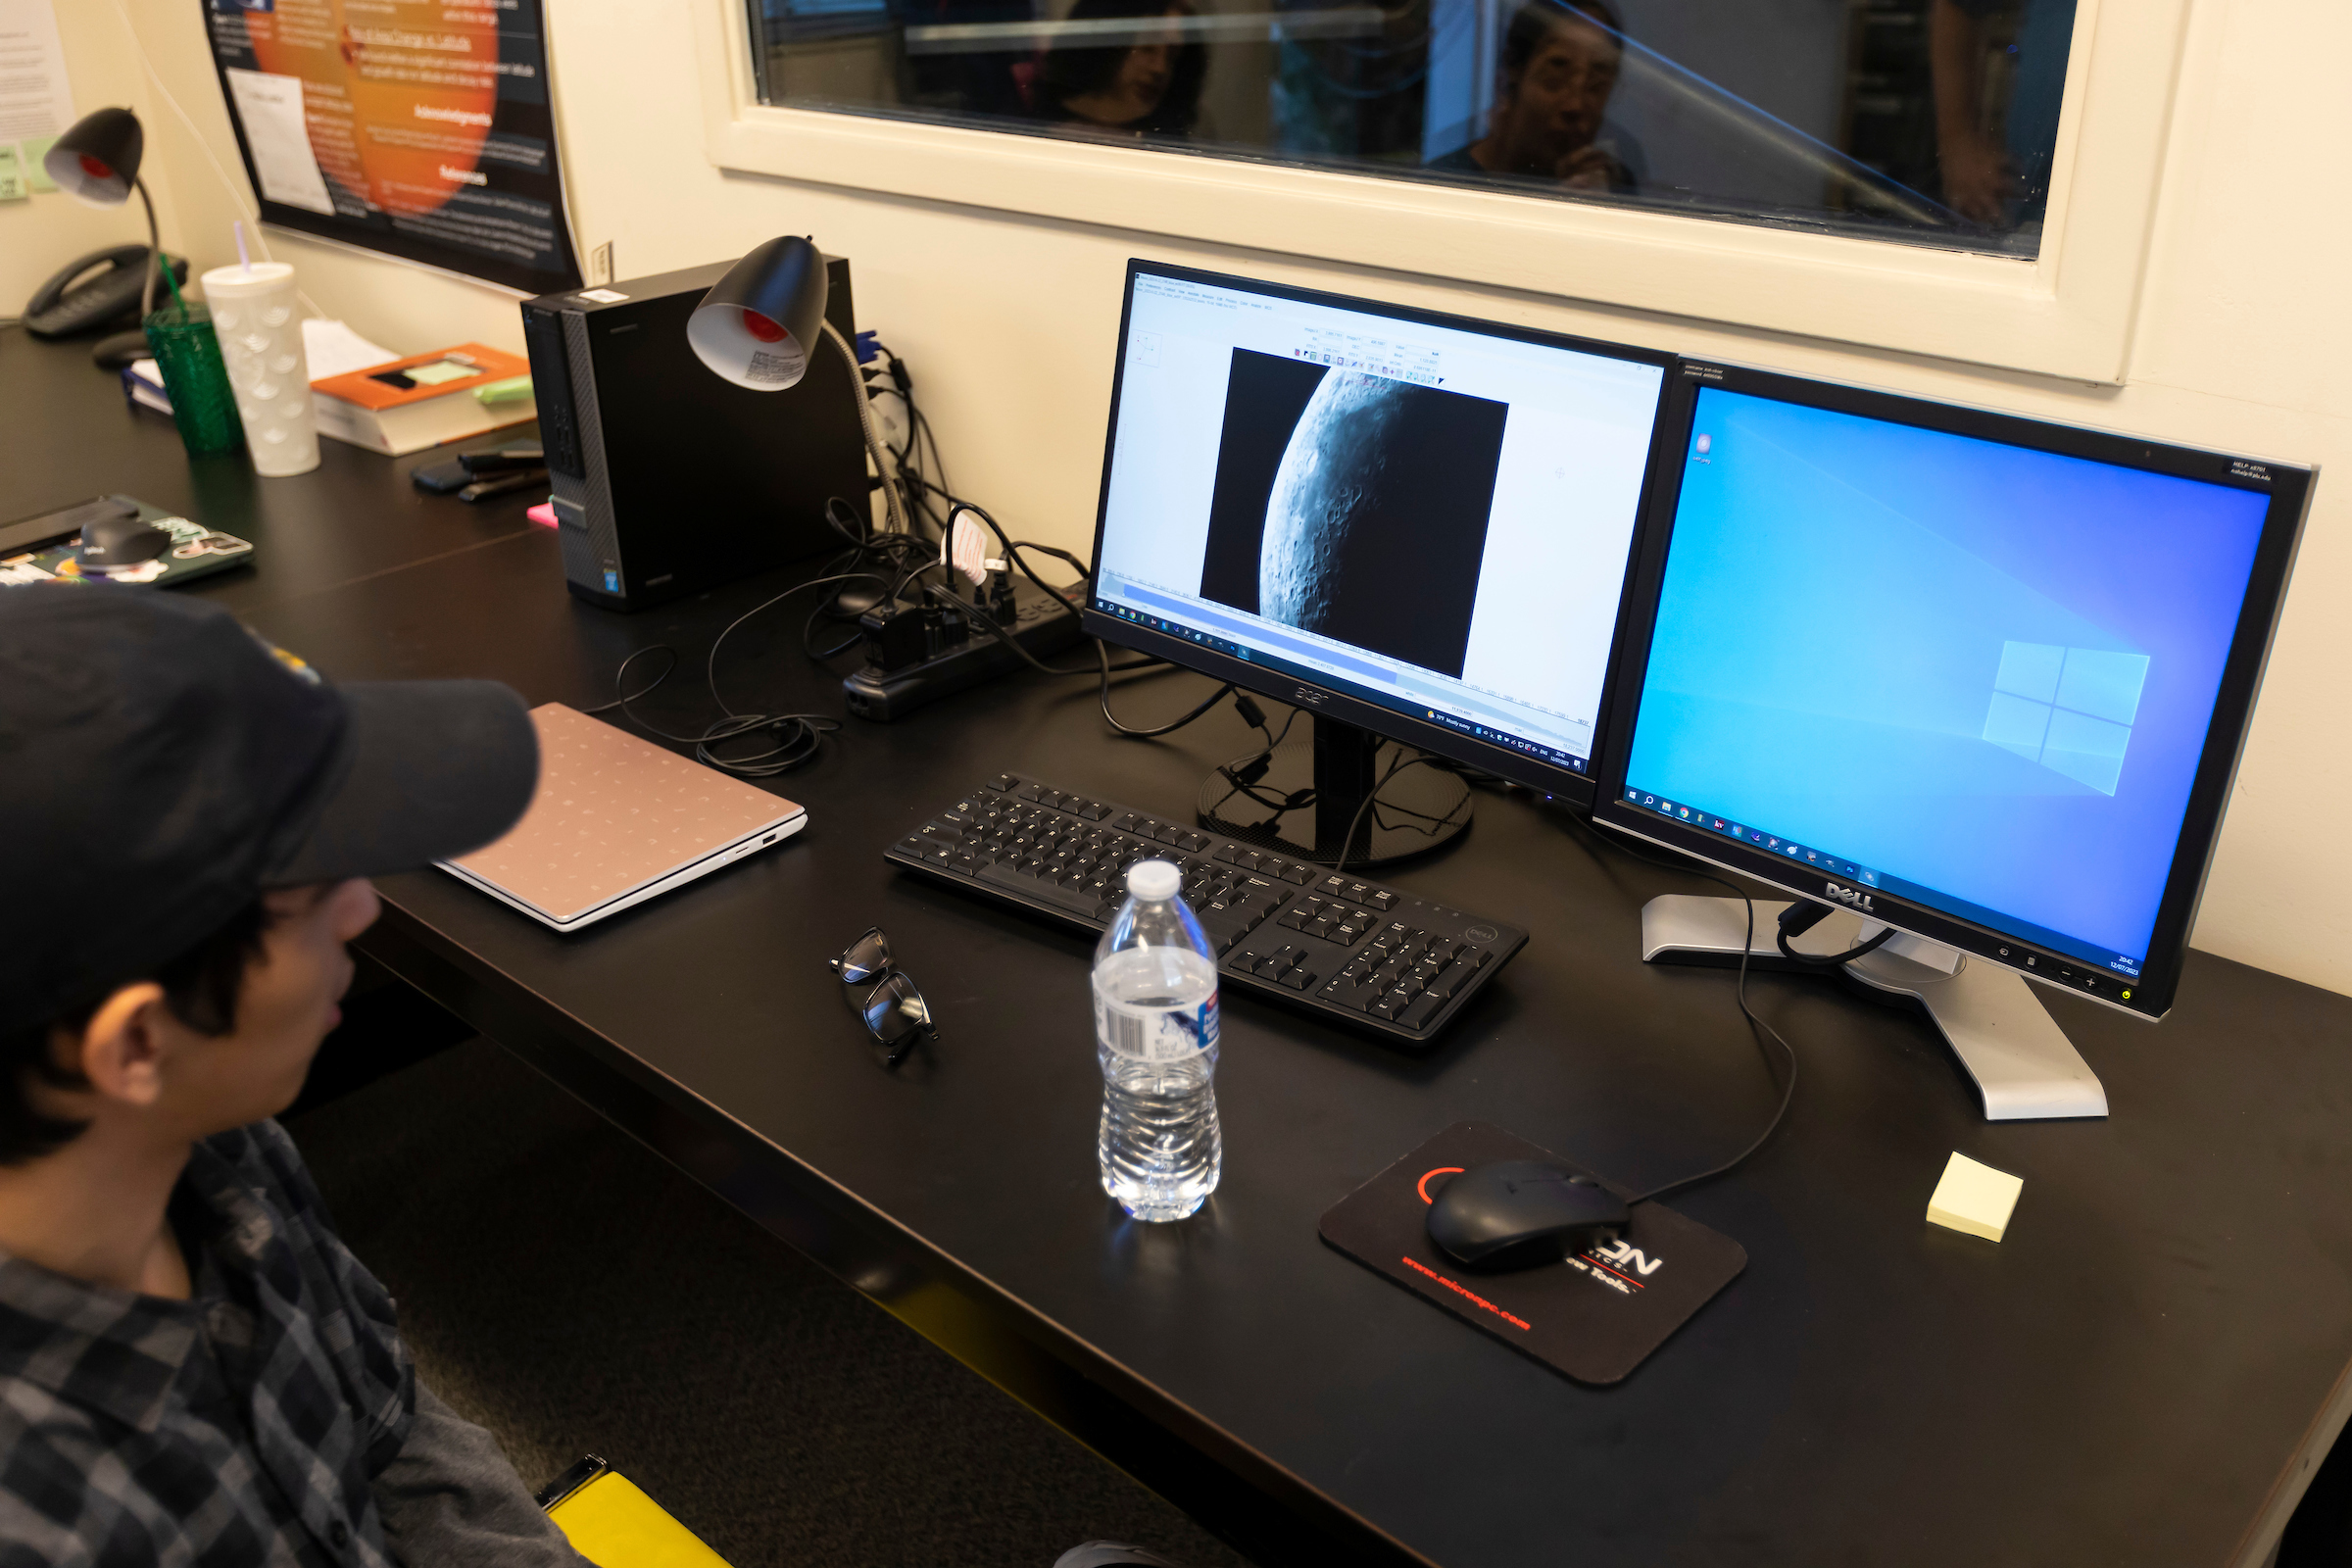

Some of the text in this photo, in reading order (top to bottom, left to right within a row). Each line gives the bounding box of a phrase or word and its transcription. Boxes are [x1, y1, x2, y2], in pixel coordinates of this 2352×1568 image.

[1295, 687, 1330, 705] acer
[1825, 881, 1874, 913] DELL
[1469, 928, 1494, 940] DELL
[2110, 961, 2139, 976] 12/07/2023
[2118, 956, 2133, 966] 20:42
[1565, 1256, 1590, 1271] ew
[1401, 1255, 1531, 1331] www.micronpc.com
